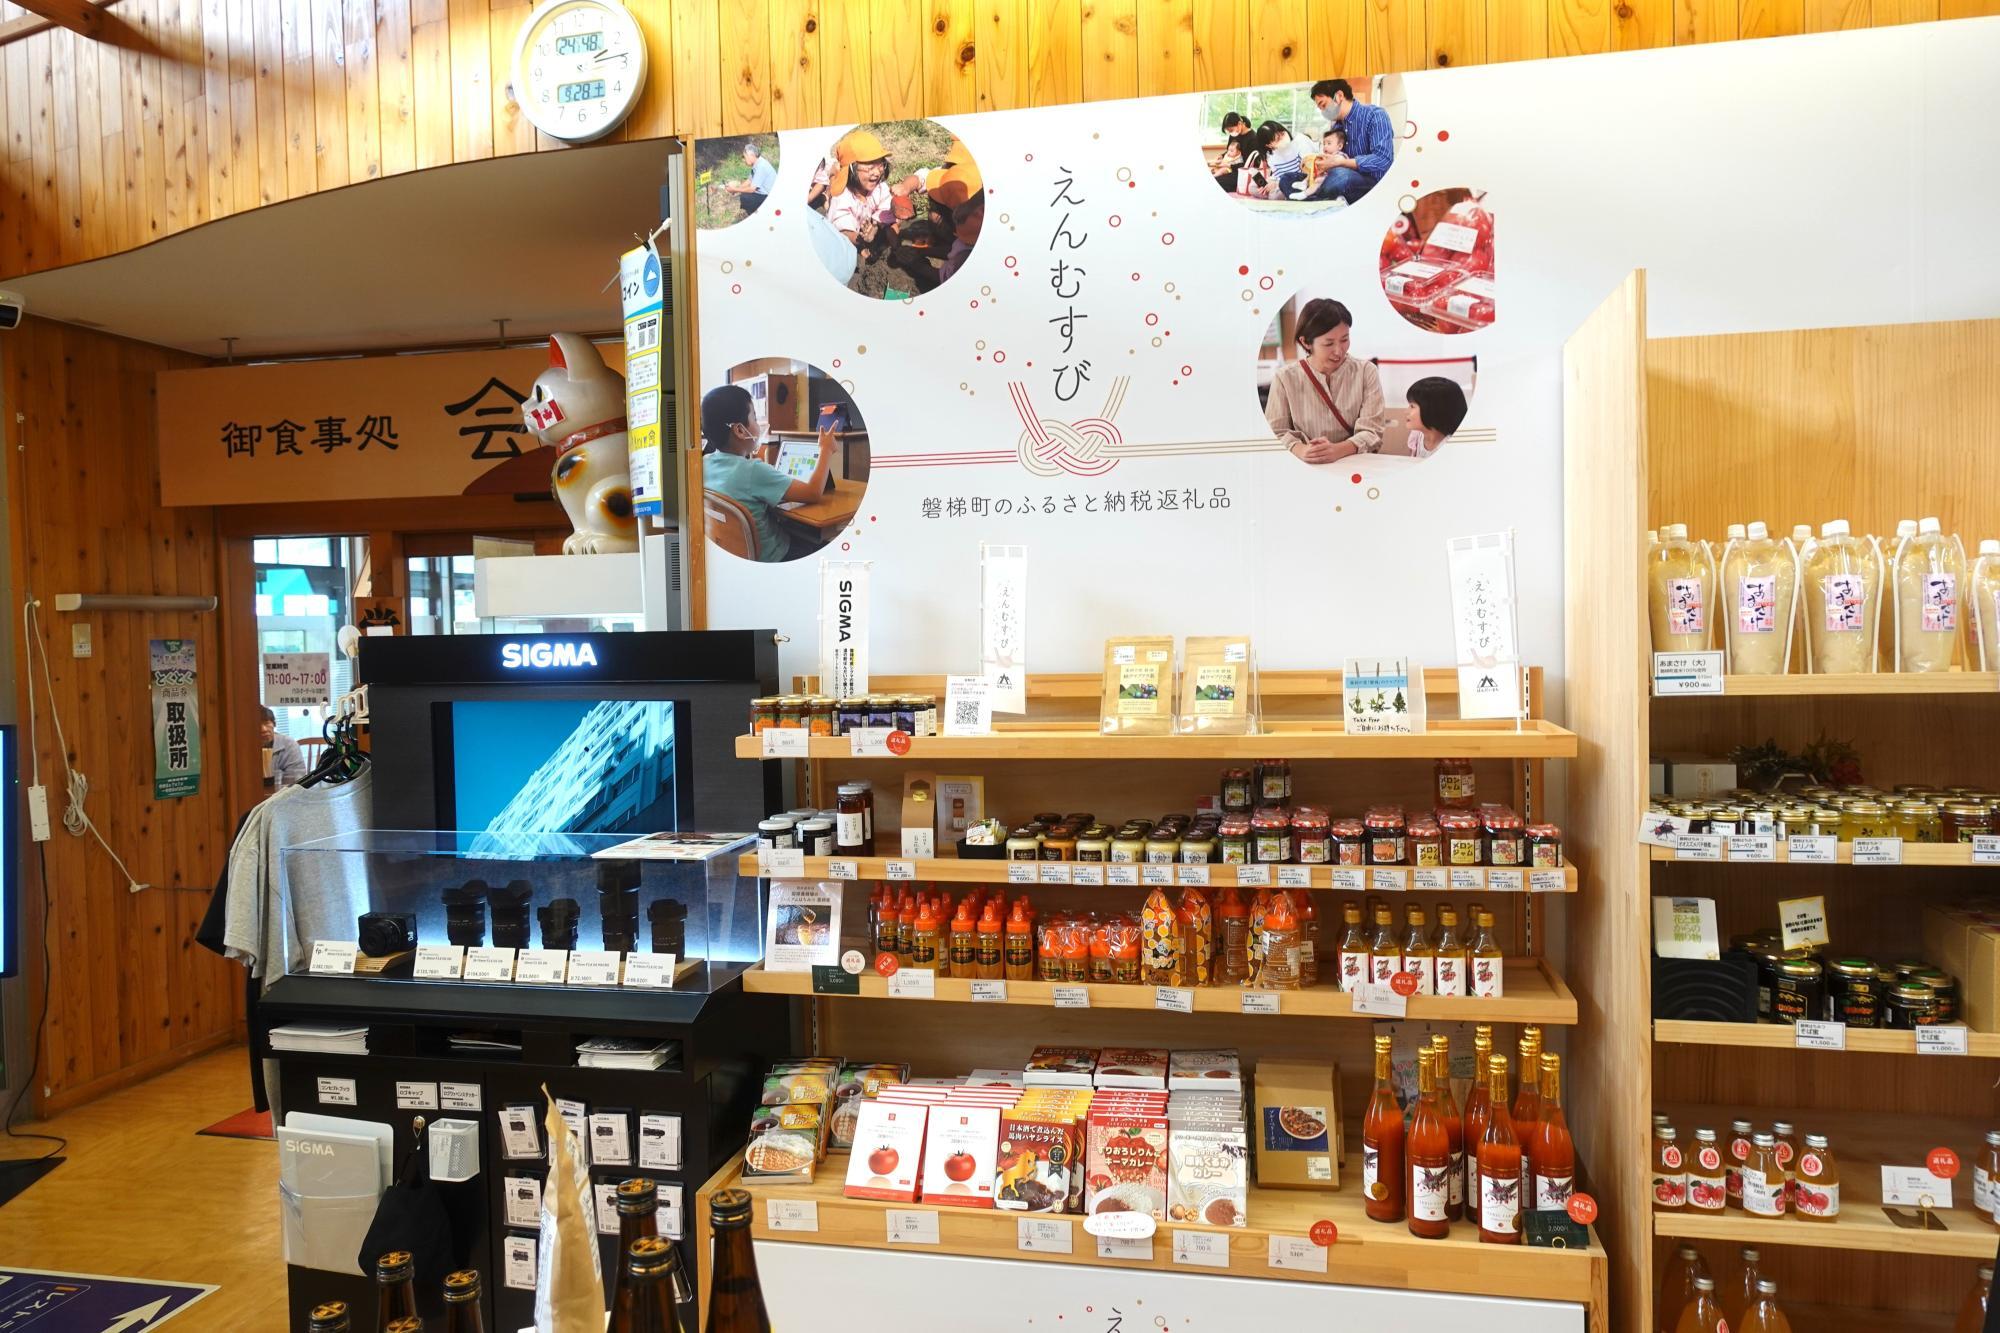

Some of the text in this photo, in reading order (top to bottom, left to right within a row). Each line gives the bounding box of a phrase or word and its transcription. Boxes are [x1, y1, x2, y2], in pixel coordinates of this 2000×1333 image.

[1049, 166, 1091, 401] えんむすび
[221, 414, 399, 458] 御食事処
[444, 376, 531, 460] 会
[921, 487, 1231, 519] 磐梯町のふるさと納税返礼品
[839, 580, 853, 643] SIGMA
[999, 586, 1012, 649] えんむすび
[1475, 580, 1490, 648] えんむすび
[501, 642, 598, 668] SIGMA
[166, 702, 189, 769] 取扱所
[285, 1139, 335, 1157] SIGMA
[1009, 1122, 1064, 1135] 日本酒で煮込んだ
[1104, 1157, 1153, 1167] キーマカレー
[1193, 1167, 1222, 1179] カレー
